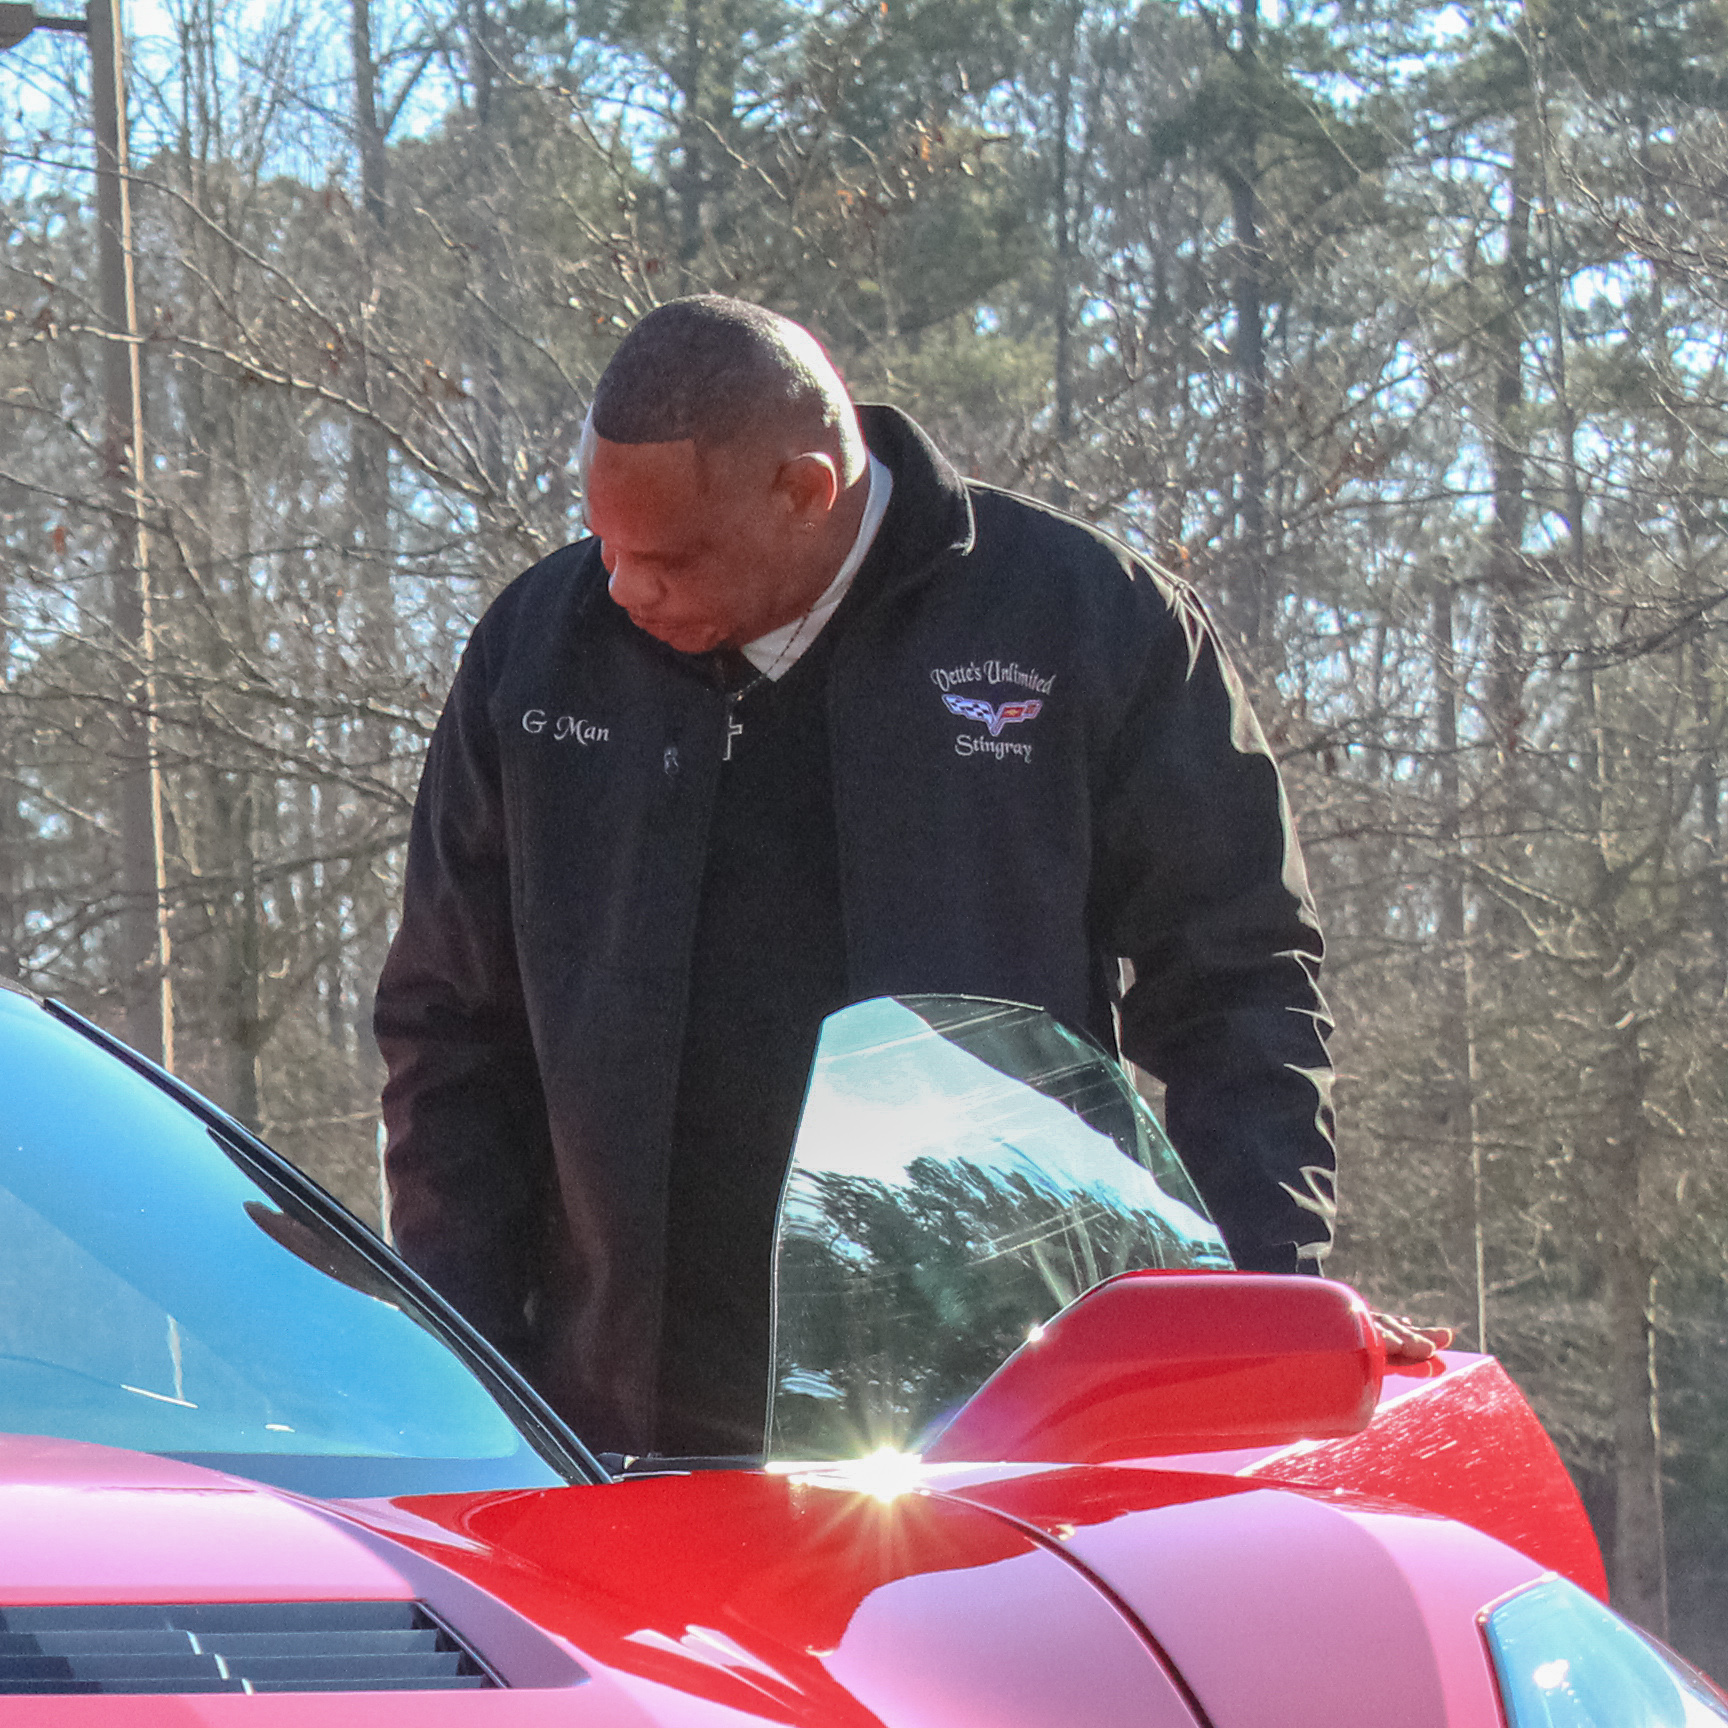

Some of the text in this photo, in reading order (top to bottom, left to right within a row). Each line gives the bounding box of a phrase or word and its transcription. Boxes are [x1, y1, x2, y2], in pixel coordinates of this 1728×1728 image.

[930, 660, 1056, 695] Vette's Unlimited
[522, 709, 609, 746] G Man
[955, 734, 1032, 763] Stingray
